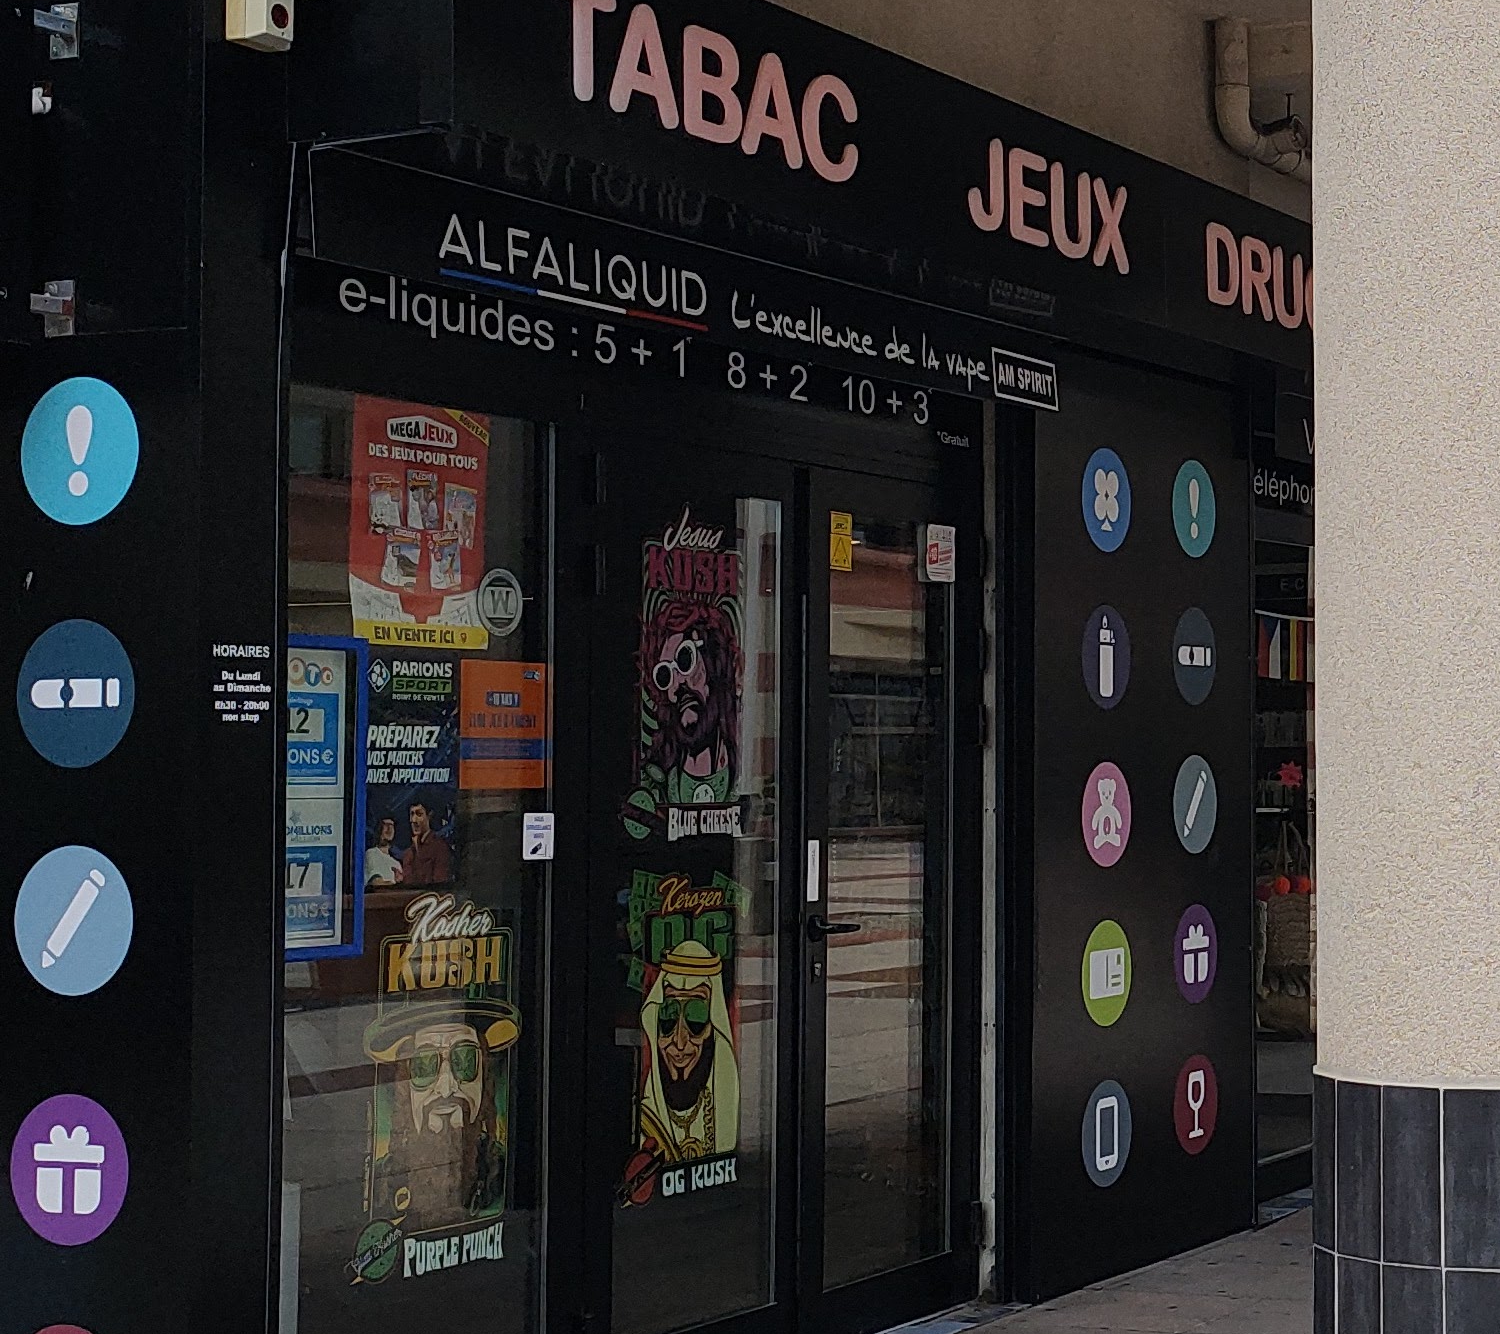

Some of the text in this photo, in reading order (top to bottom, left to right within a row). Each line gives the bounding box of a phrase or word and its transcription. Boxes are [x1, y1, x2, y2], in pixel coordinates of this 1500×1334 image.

[967, 136, 1130, 275] JEUX
[1206, 220, 1313, 330] DRU
[439, 213, 708, 317] ALFALIQUID
[339, 275, 555, 352] e-liquides
[595, 323, 616, 365] 5
[631, 338, 653, 366] +
[727, 351, 747, 390] 8
[759, 364, 778, 390] +
[842, 375, 876, 415] 10
[886, 390, 903, 414] +
[885, 326, 915, 365] de
[1018, 365, 1054, 398] SPIRIT
[368, 442, 479, 470] DES JEUX POUR TOUS
[664, 505, 724, 552] Jesus
[647, 545, 738, 595] KUSH
[490, 589, 514, 615] W
[373, 625, 454, 644] EN VENTE ICI
[212, 644, 271, 659] HORAIRES
[221, 670, 261, 681] Du Lundi
[392, 660, 453, 678] PARIONS
[213, 682, 272, 693] au Dimanche
[394, 679, 451, 692] SPORT
[222, 713, 260, 724] non stop
[243, 700, 270, 711] 20h00
[366, 722, 442, 749] PRÉPAREZ
[366, 750, 426, 766] VOS MATCHS
[365, 767, 451, 784] AVEC APPLICATION
[667, 805, 743, 842] BLUE CHEESE
[659, 876, 723, 916] Kerozen
[406, 895, 492, 945] Kosher
[387, 935, 504, 993] KUSH
[661, 1168, 686, 1198] OG
[691, 1157, 738, 1192] KUSH
[403, 1235, 460, 1278] PURPLE
[461, 1220, 505, 1265] PUNCH
